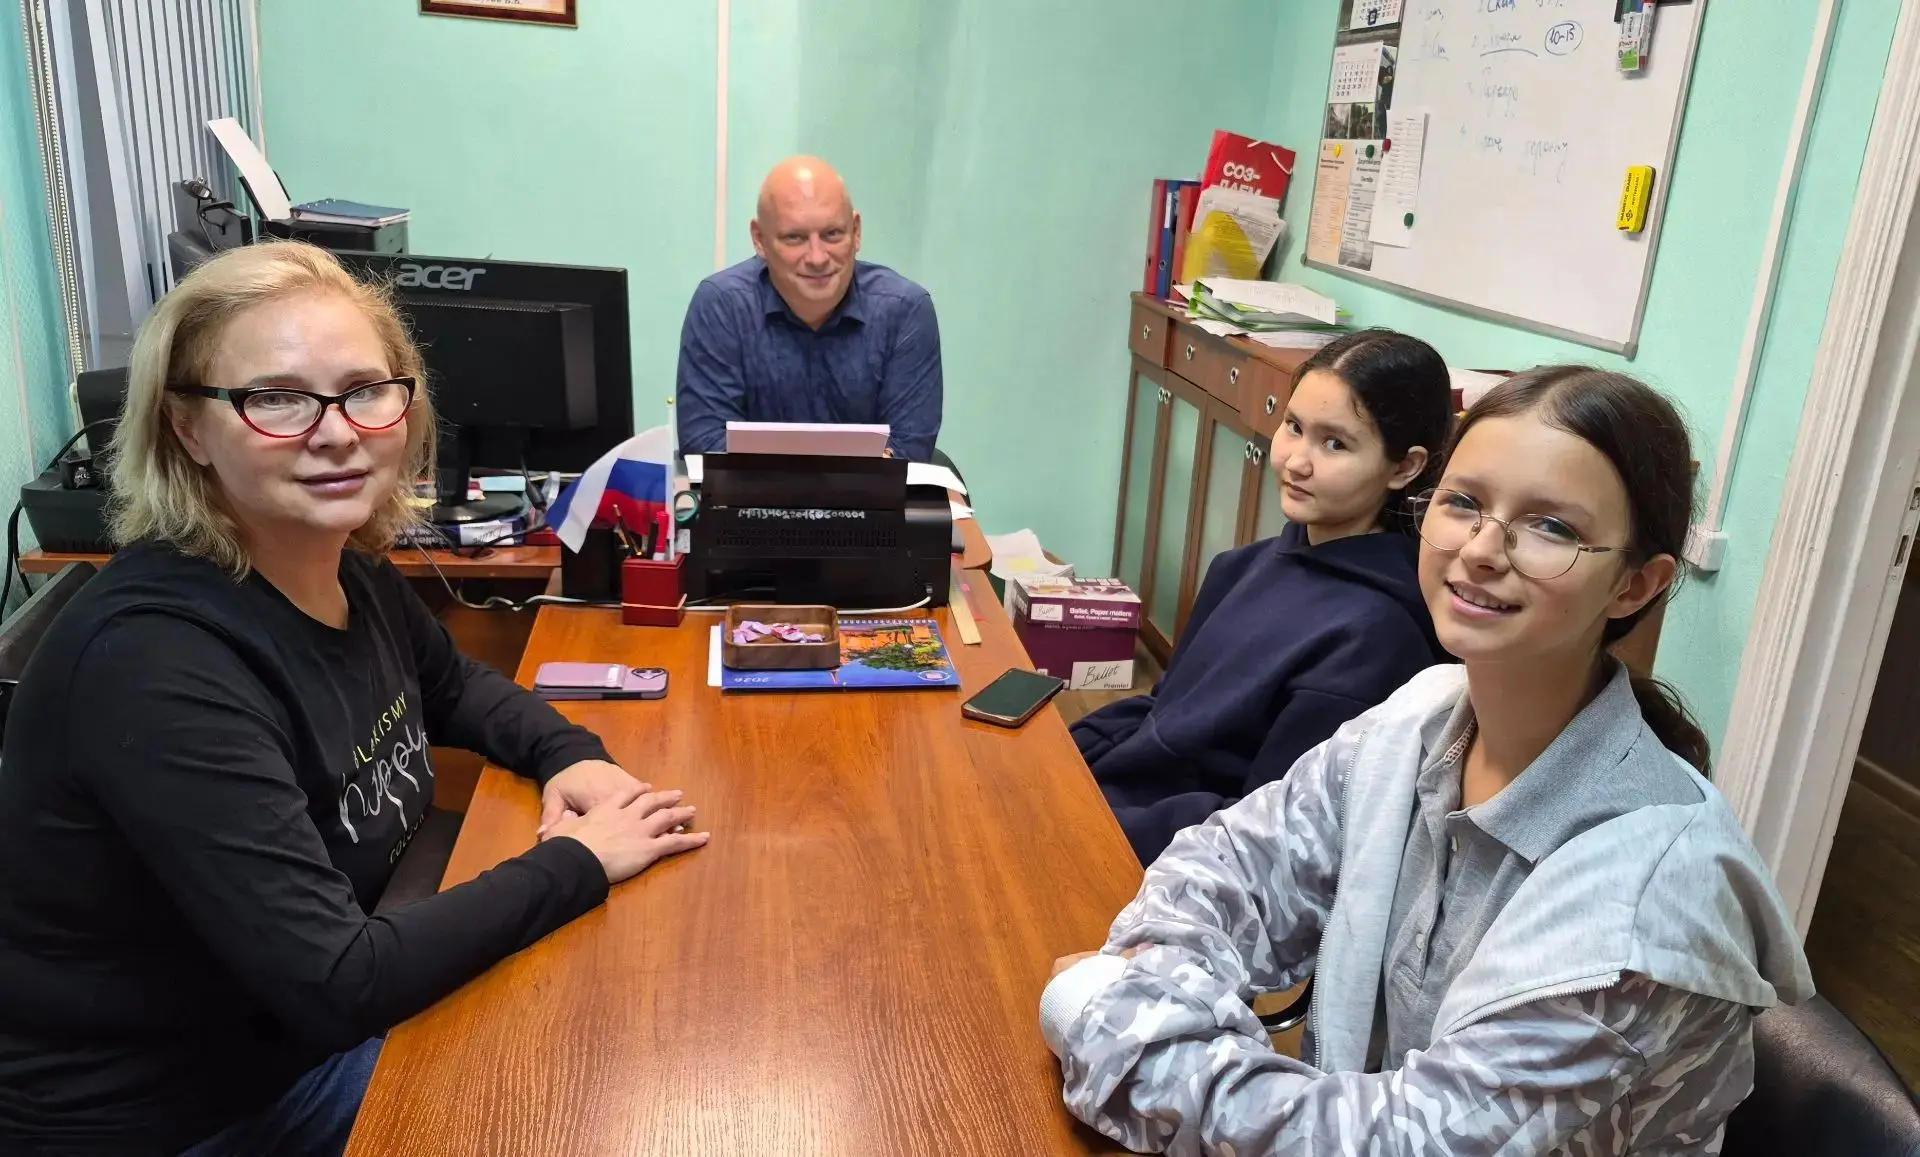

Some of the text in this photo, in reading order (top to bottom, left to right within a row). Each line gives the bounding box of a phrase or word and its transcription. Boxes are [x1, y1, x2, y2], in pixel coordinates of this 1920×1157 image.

[1549, 25, 1576, 46] 10-15
[1222, 161, 1262, 183] СОЗ-
[396, 263, 487, 291] acer
[1080, 664, 1120, 688] Ballet
